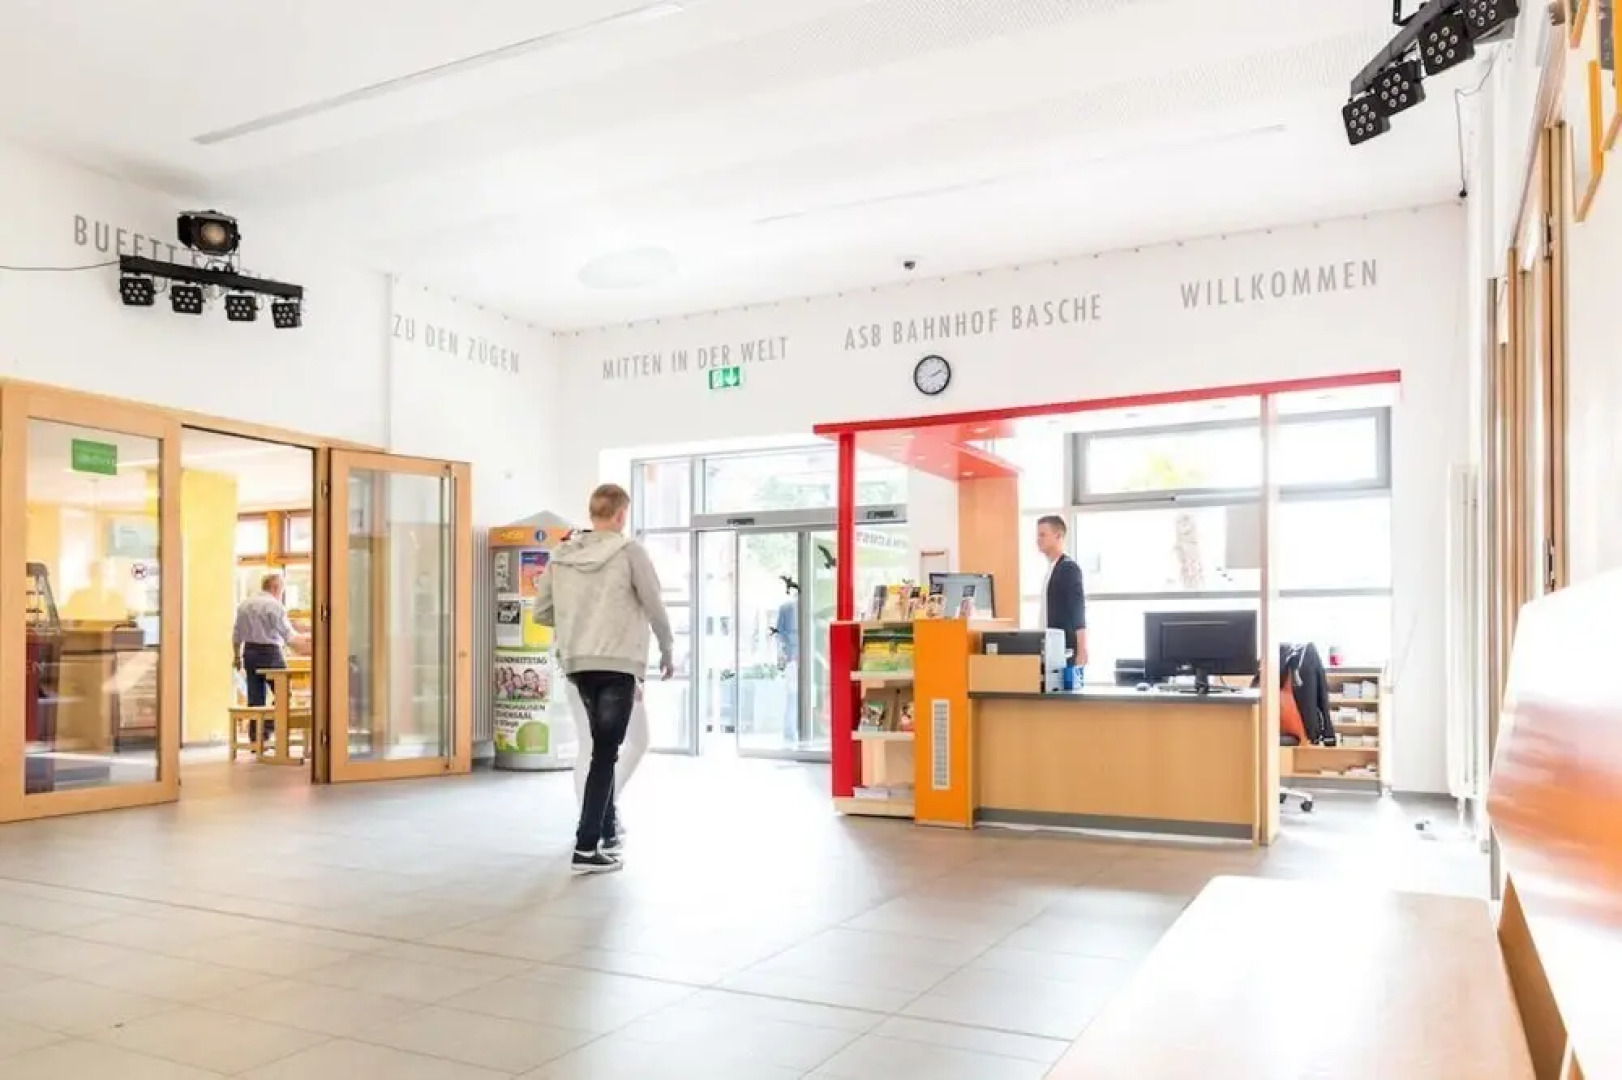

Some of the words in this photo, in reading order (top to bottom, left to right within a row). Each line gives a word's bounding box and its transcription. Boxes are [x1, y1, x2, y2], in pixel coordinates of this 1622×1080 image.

[1180, 258, 1377, 309] WILLKOMMEN
[392, 313, 415, 342] ZU
[424, 322, 459, 356] DEN
[467, 336, 520, 374] ZÜGEN
[844, 322, 882, 351] ASB
[893, 307, 998, 345] BAHNHOF
[1011, 293, 1102, 330] BASCHE
[602, 353, 662, 381] MITTEN
[671, 349, 688, 373] IN
[699, 344, 731, 369] DER
[740, 335, 789, 362] WELT
